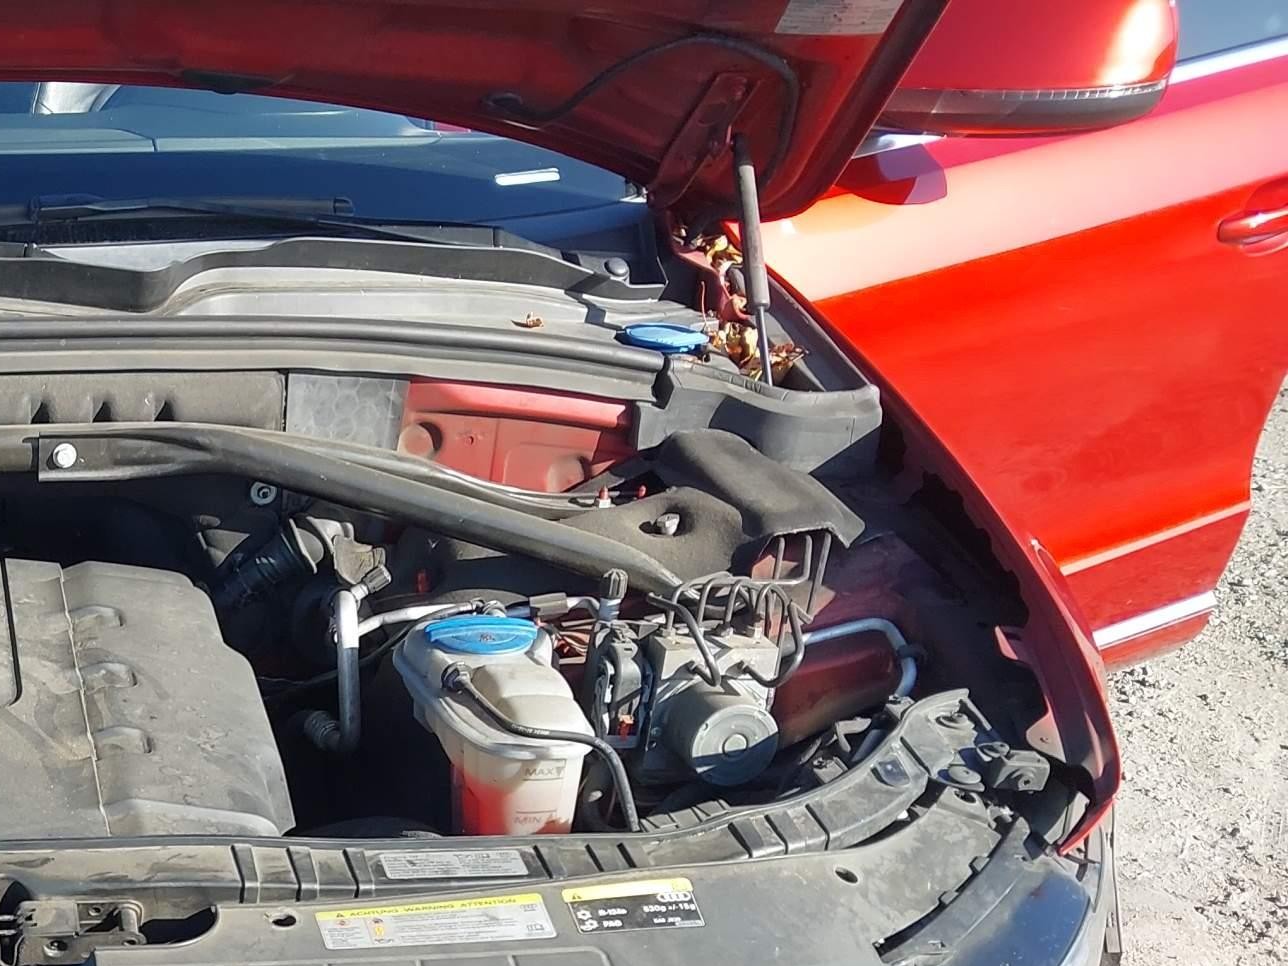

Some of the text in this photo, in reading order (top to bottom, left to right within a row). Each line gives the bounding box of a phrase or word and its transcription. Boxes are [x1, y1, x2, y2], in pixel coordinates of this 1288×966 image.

[524, 767, 554, 777] MAX
[515, 816, 542, 825] MIN
[349, 898, 517, 918] ACHTUNG WARNING ATTENTION
